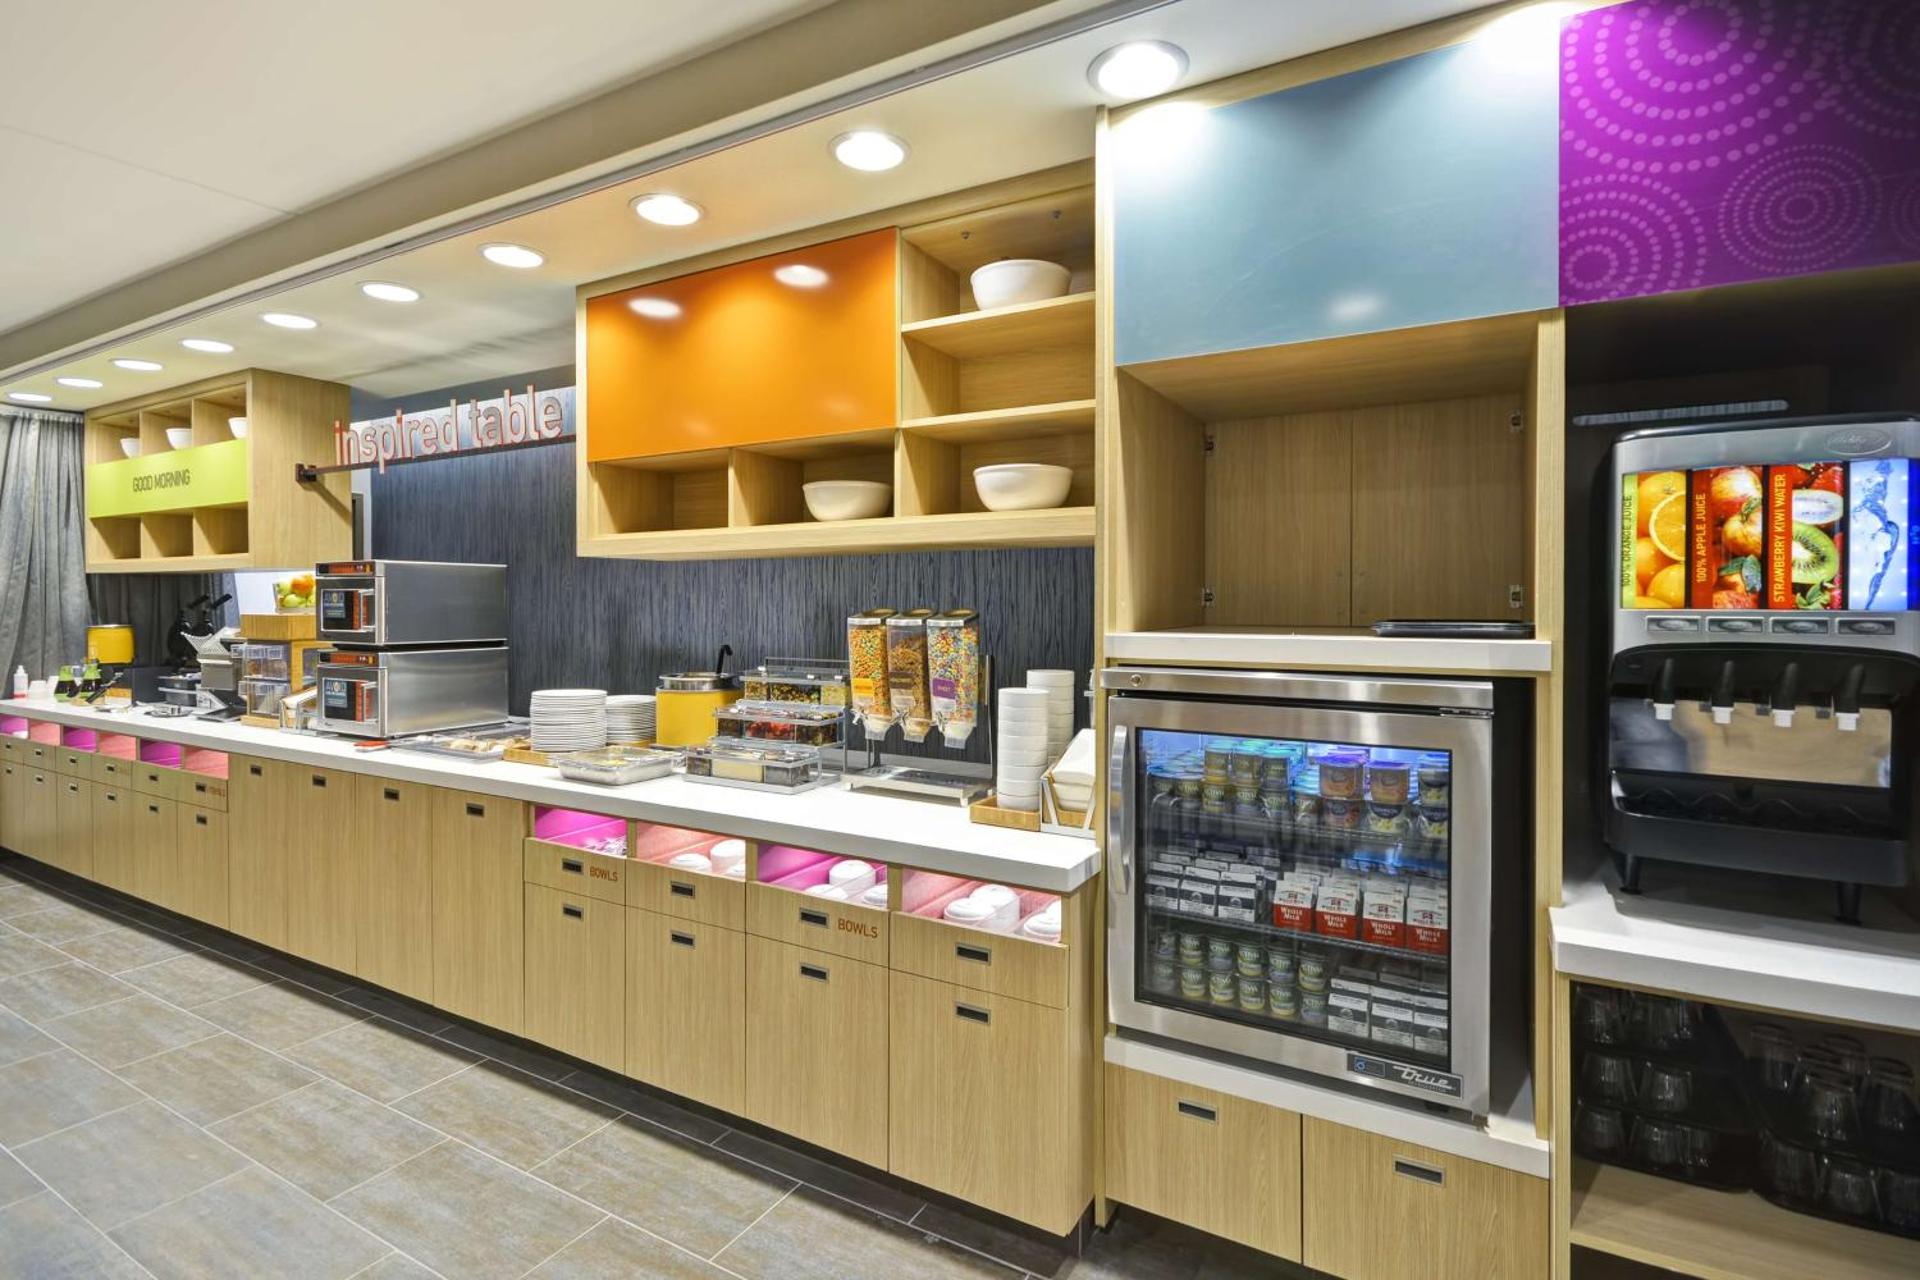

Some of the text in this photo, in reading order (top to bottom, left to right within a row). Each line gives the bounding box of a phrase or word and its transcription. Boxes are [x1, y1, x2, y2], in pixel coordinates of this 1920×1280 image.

[335, 384, 562, 474] inspired table
[132, 469, 191, 492] GOOD MORNING
[1622, 495, 1632, 523] JUICE
[1622, 524, 1632, 562] ORANGE
[1695, 493, 1707, 583] 100% APPLE JUICE
[1773, 473, 1786, 603] STRAWBERRY KIWI WATER
[589, 866, 618, 883] BOWLS
[837, 918, 878, 939] BOWLS
